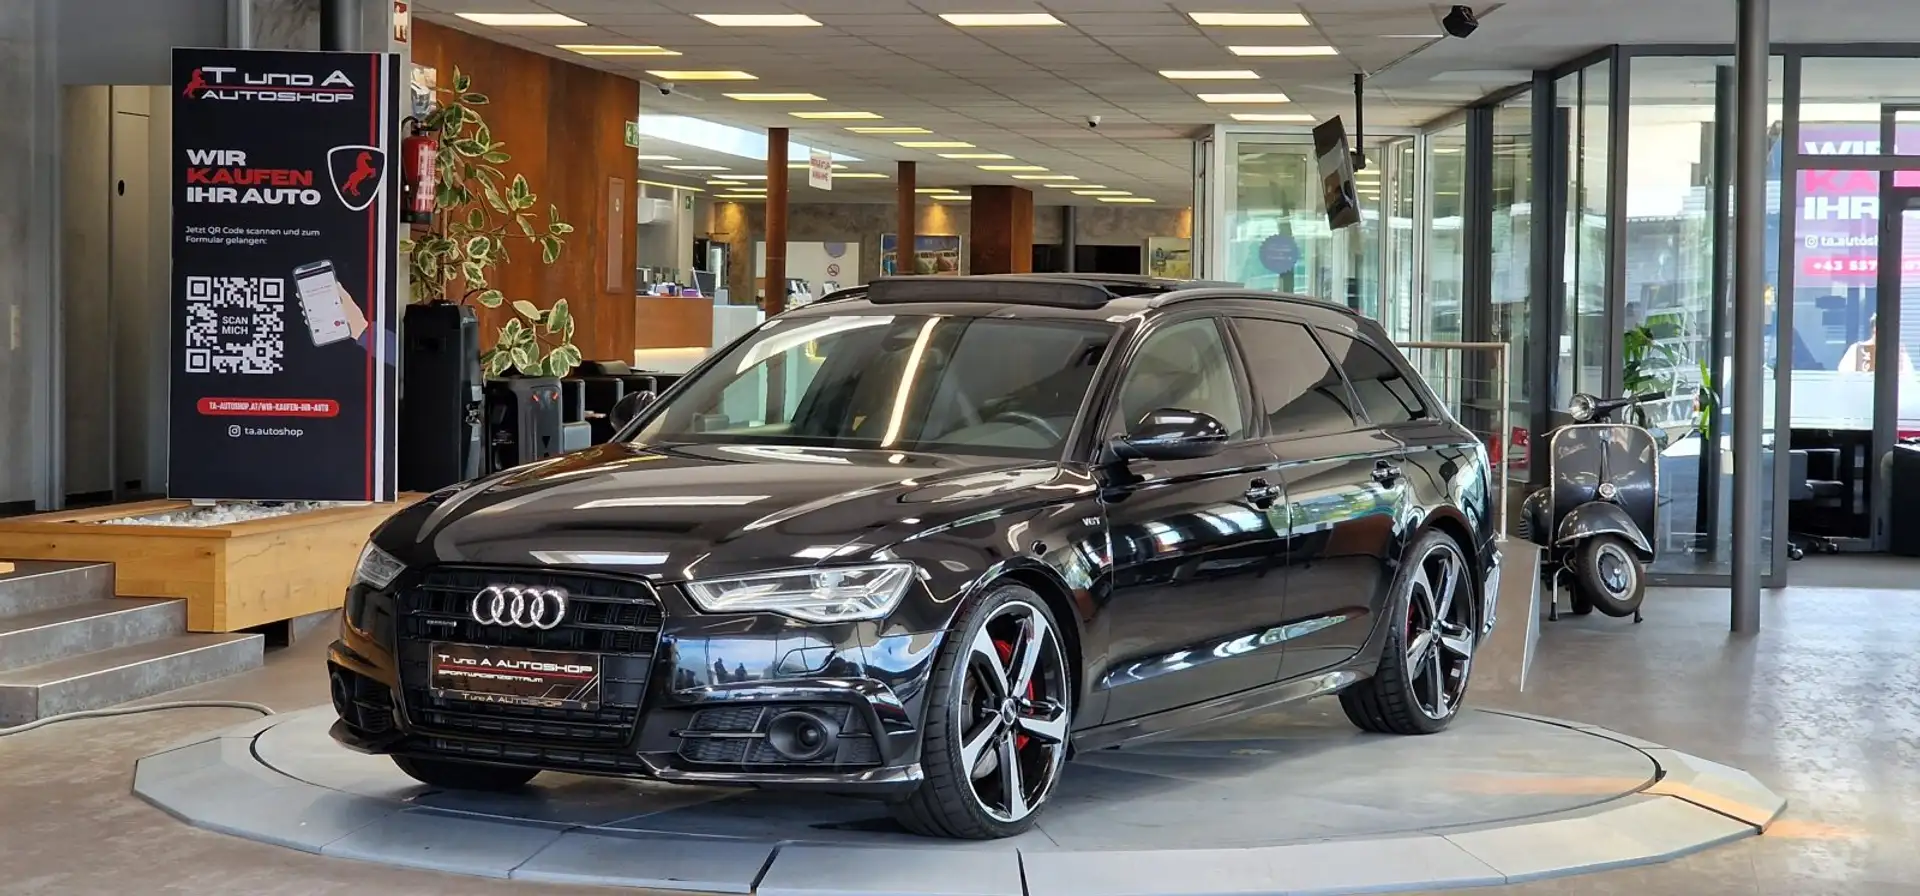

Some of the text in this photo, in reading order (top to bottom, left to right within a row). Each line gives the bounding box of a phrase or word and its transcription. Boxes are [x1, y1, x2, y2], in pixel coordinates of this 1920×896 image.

[202, 66, 236, 84] T
[321, 69, 355, 87] A
[201, 90, 354, 103] AUTOSHOP
[186, 149, 247, 166] WIR
[187, 168, 313, 186] KAUFEN
[187, 187, 322, 205] IHR AUTO
[1804, 196, 1879, 220] IHR
[185, 226, 206, 234] Jetzt
[207, 226, 221, 235] QR
[222, 226, 244, 234] Code
[283, 228, 300, 236] und
[185, 235, 268, 246] Formular gelangen:
[1813, 260, 1878, 271] +43 557
[221, 316, 249, 325] SCAN
[221, 326, 249, 335] MICH
[244, 427, 304, 438] ta.autoshop
[438, 654, 450, 663] T
[480, 658, 492, 667] A
[496, 659, 593, 673] AUTOSHOP
[438, 669, 543, 683] SPORTWAGENZENTRUM
[486, 694, 496, 702] A
[498, 695, 563, 707] AUTOSHOP
